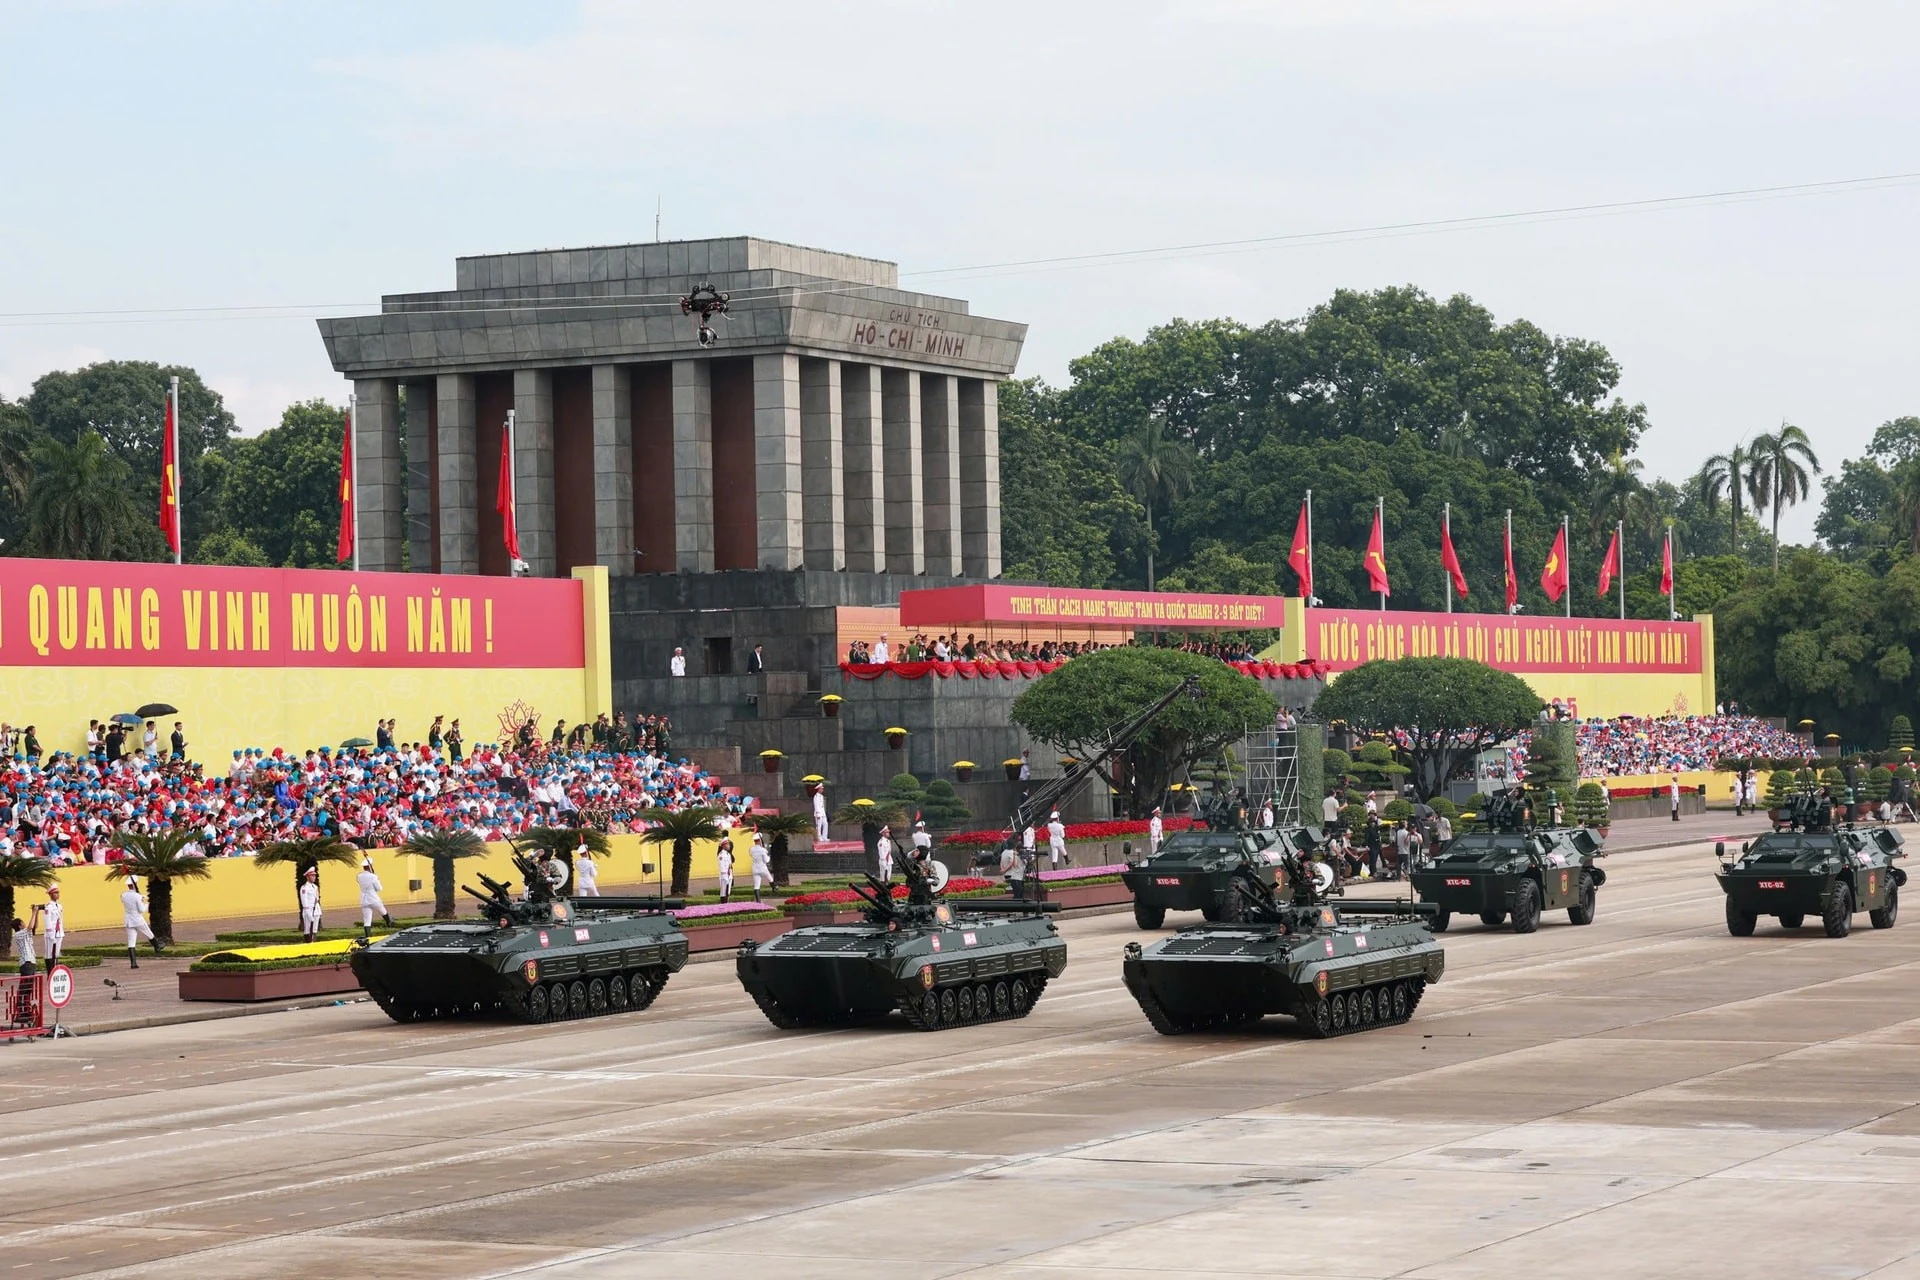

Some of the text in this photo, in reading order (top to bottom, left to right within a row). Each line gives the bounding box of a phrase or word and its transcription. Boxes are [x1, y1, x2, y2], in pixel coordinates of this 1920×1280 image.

[29, 584, 160, 656] QUANG
[182, 590, 270, 651] VINH
[291, 584, 387, 653] MUÔN
[407, 587, 473, 653] NĂM
[1010, 597, 1032, 615] TINH
[1060, 595, 1081, 616] CÁCH
[1083, 600, 1106, 620] MẠNG
[1107, 598, 1134, 618] THÁNG
[1136, 599, 1153, 618] TÁM
[1154, 600, 1165, 618] VÀ
[1166, 599, 1186, 620] QUỐC
[1187, 600, 1213, 620] KHÁNH
[1229, 600, 1244, 620] BẤT
[1320, 617, 1359, 662] NƯỚC
[1412, 620, 1438, 657] HÒA
[1444, 621, 1460, 658] XÃ
[1495, 619, 1520, 663] CHỦ
[1525, 624, 1562, 664] NGHĨA
[1567, 624, 1592, 670] VIỆT
[1597, 631, 1620, 664] NAM
[1626, 626, 1656, 664] MUÔN
